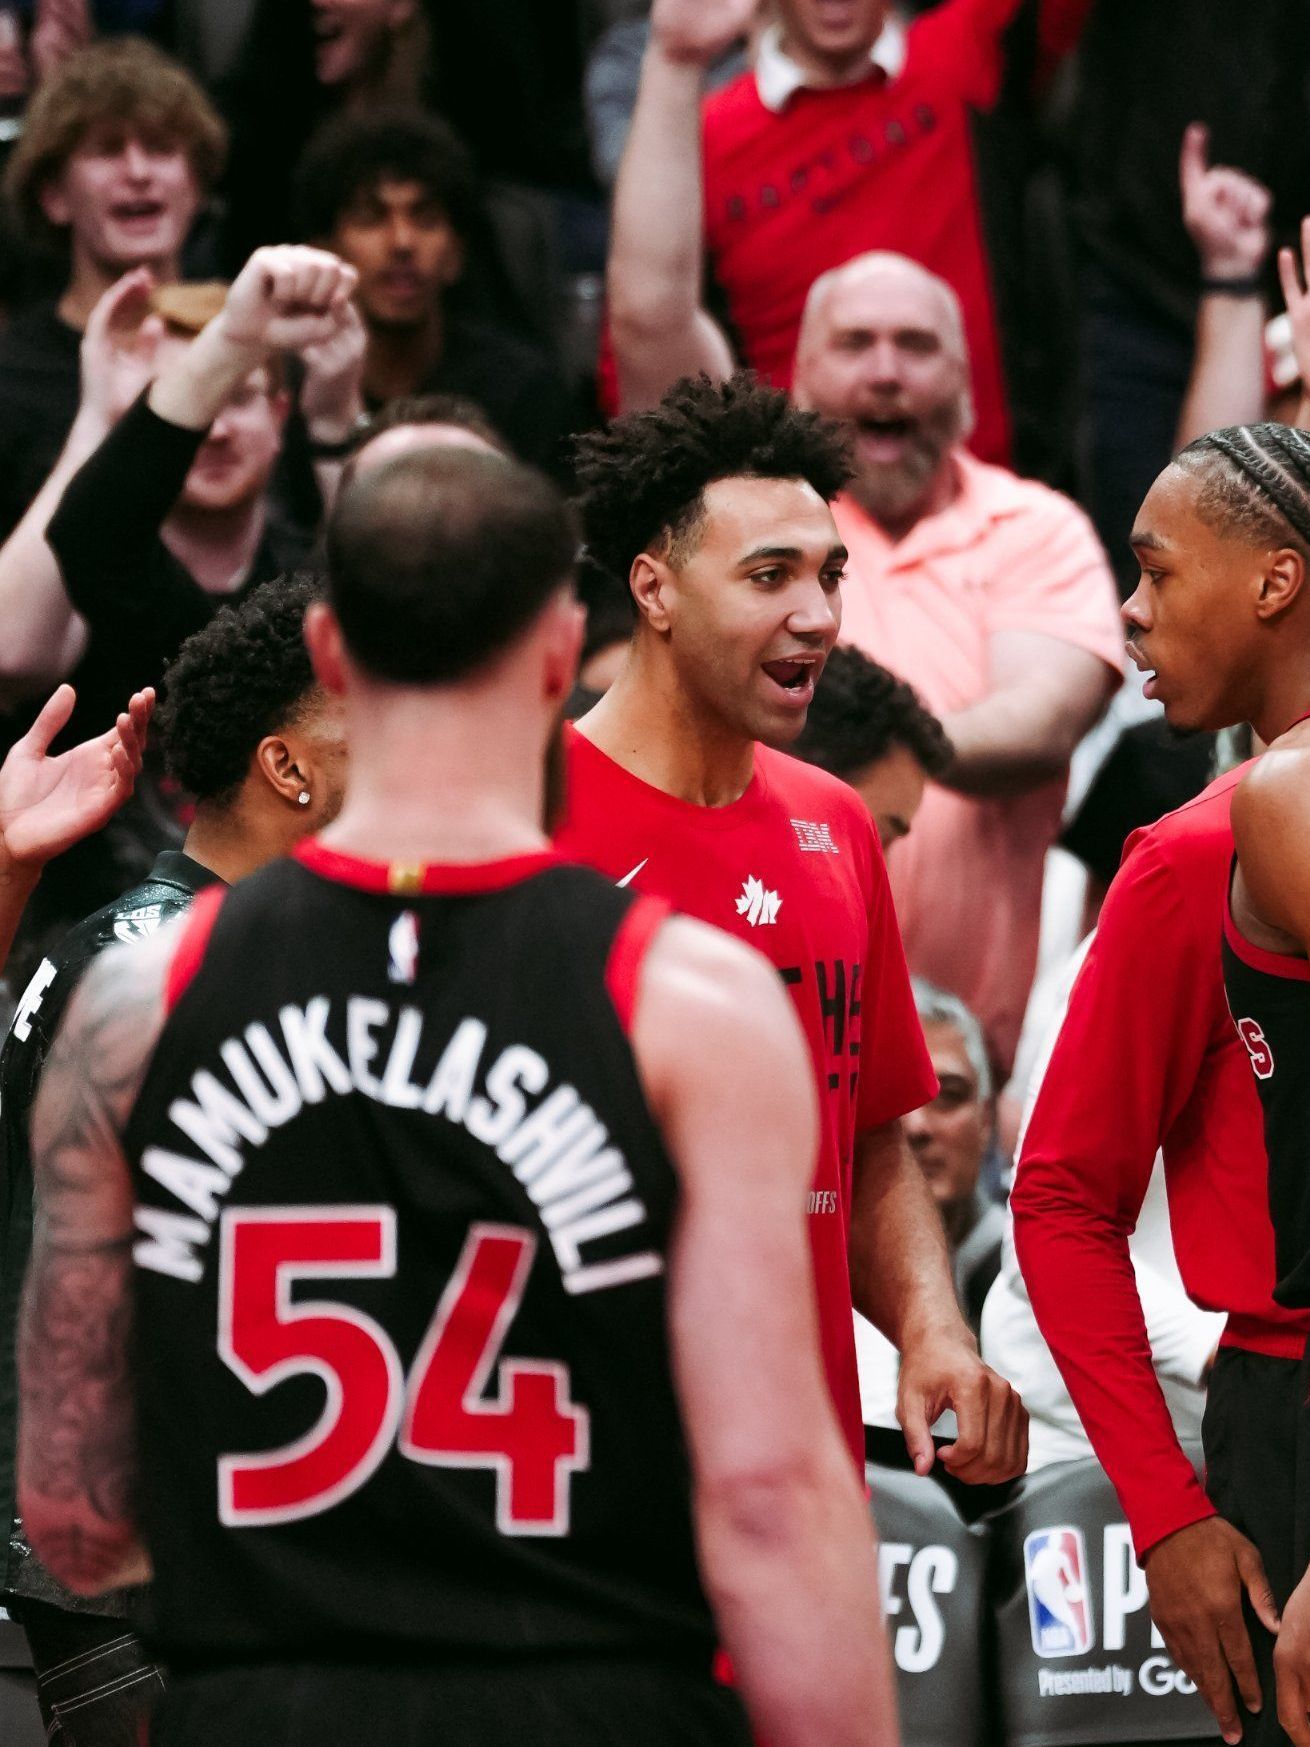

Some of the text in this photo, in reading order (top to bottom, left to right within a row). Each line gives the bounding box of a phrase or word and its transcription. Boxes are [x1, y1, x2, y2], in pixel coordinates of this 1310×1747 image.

[789, 818, 839, 854] IBM
[131, 995, 664, 1296] MAMUKELASHVILI
[217, 1203, 590, 1537] 54
